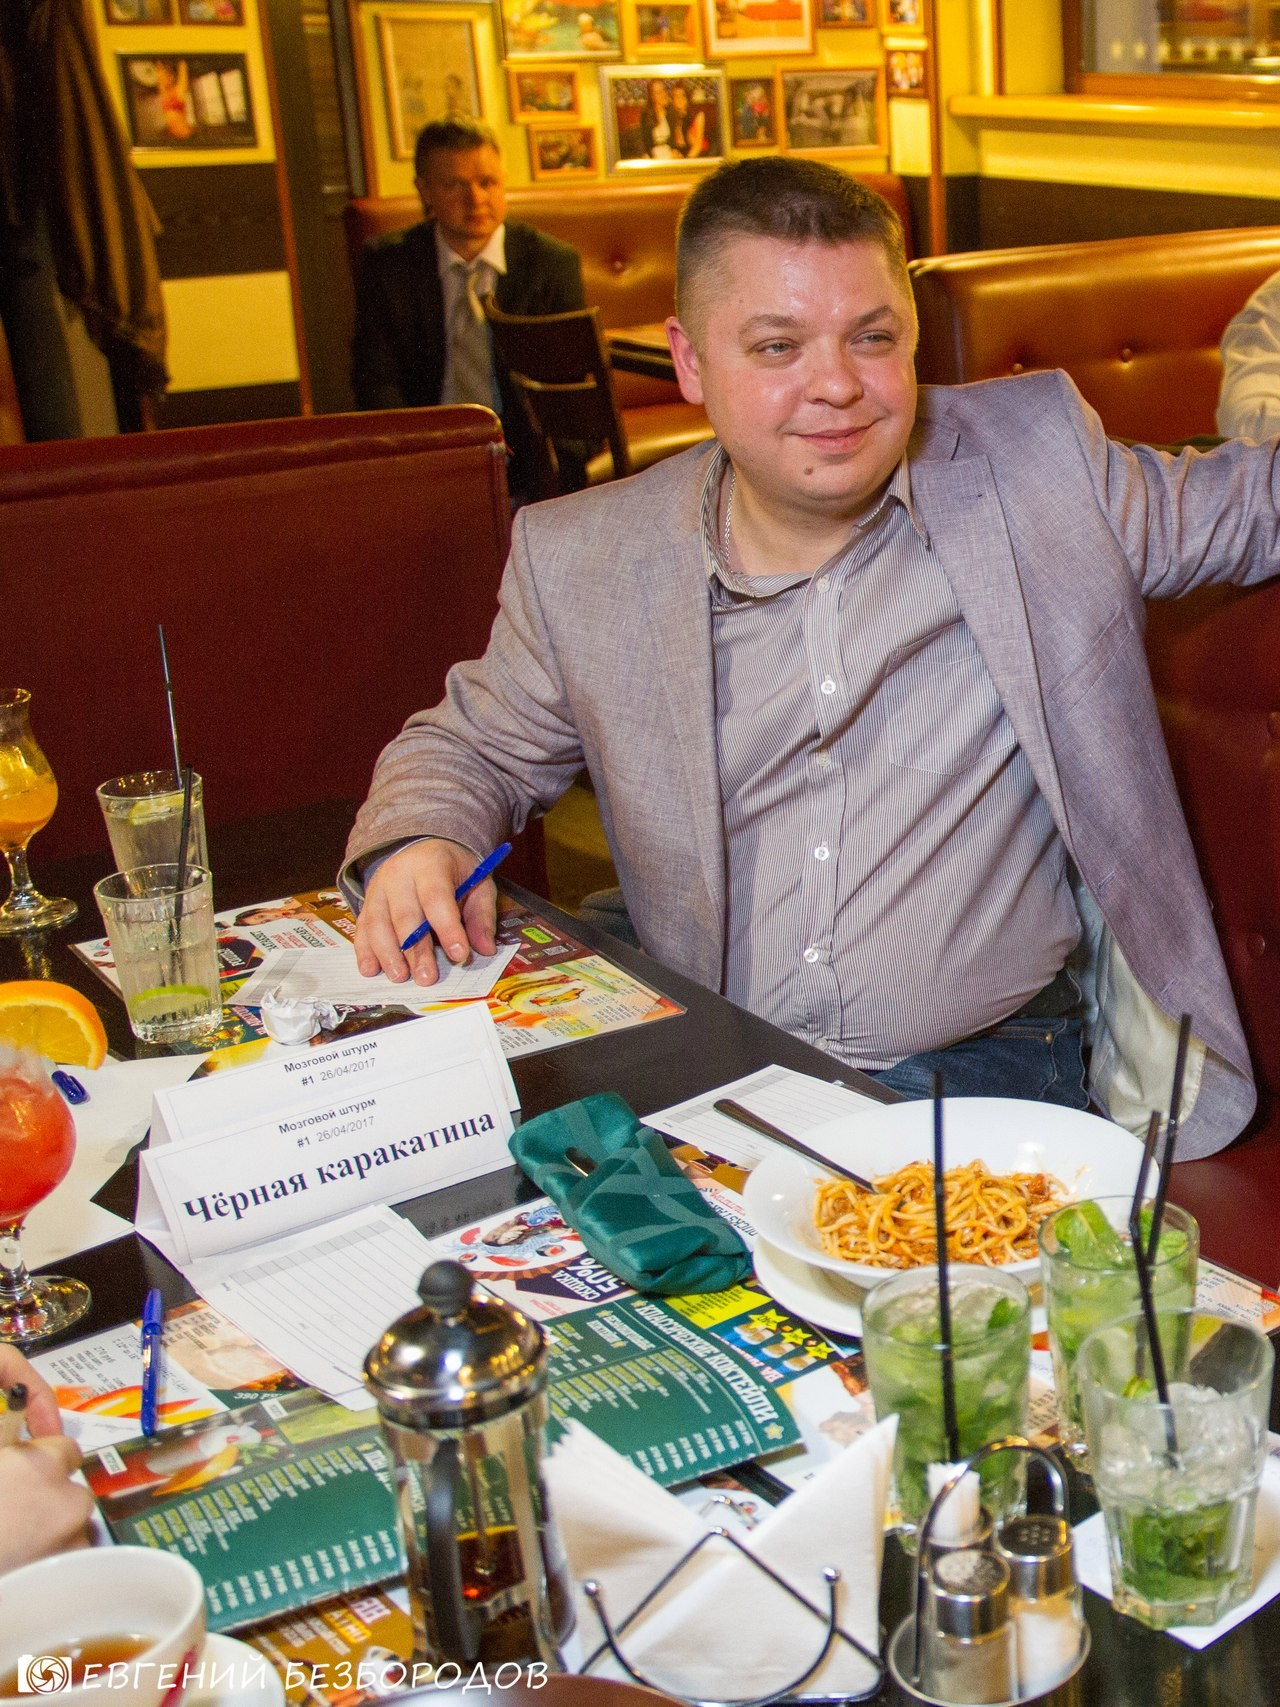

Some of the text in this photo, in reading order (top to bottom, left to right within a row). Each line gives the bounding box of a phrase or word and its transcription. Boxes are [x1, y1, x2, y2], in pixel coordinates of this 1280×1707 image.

[284, 1040, 378, 1074] Мозговой штурм
[301, 1057, 377, 1087] #1 26/04/2017
[278, 1096, 377, 1135] Мозговой штурм
[296, 1115, 375, 1148] #1 26/04/2017
[182, 1112, 497, 1224] Чёрная каракатица
[551, 1269, 601, 1300] СКИДКА
[636, 1303, 720, 1365] КЛАССИЧЕСКИЕ
[708, 1352, 779, 1424] КОКТЕЙЛИ
